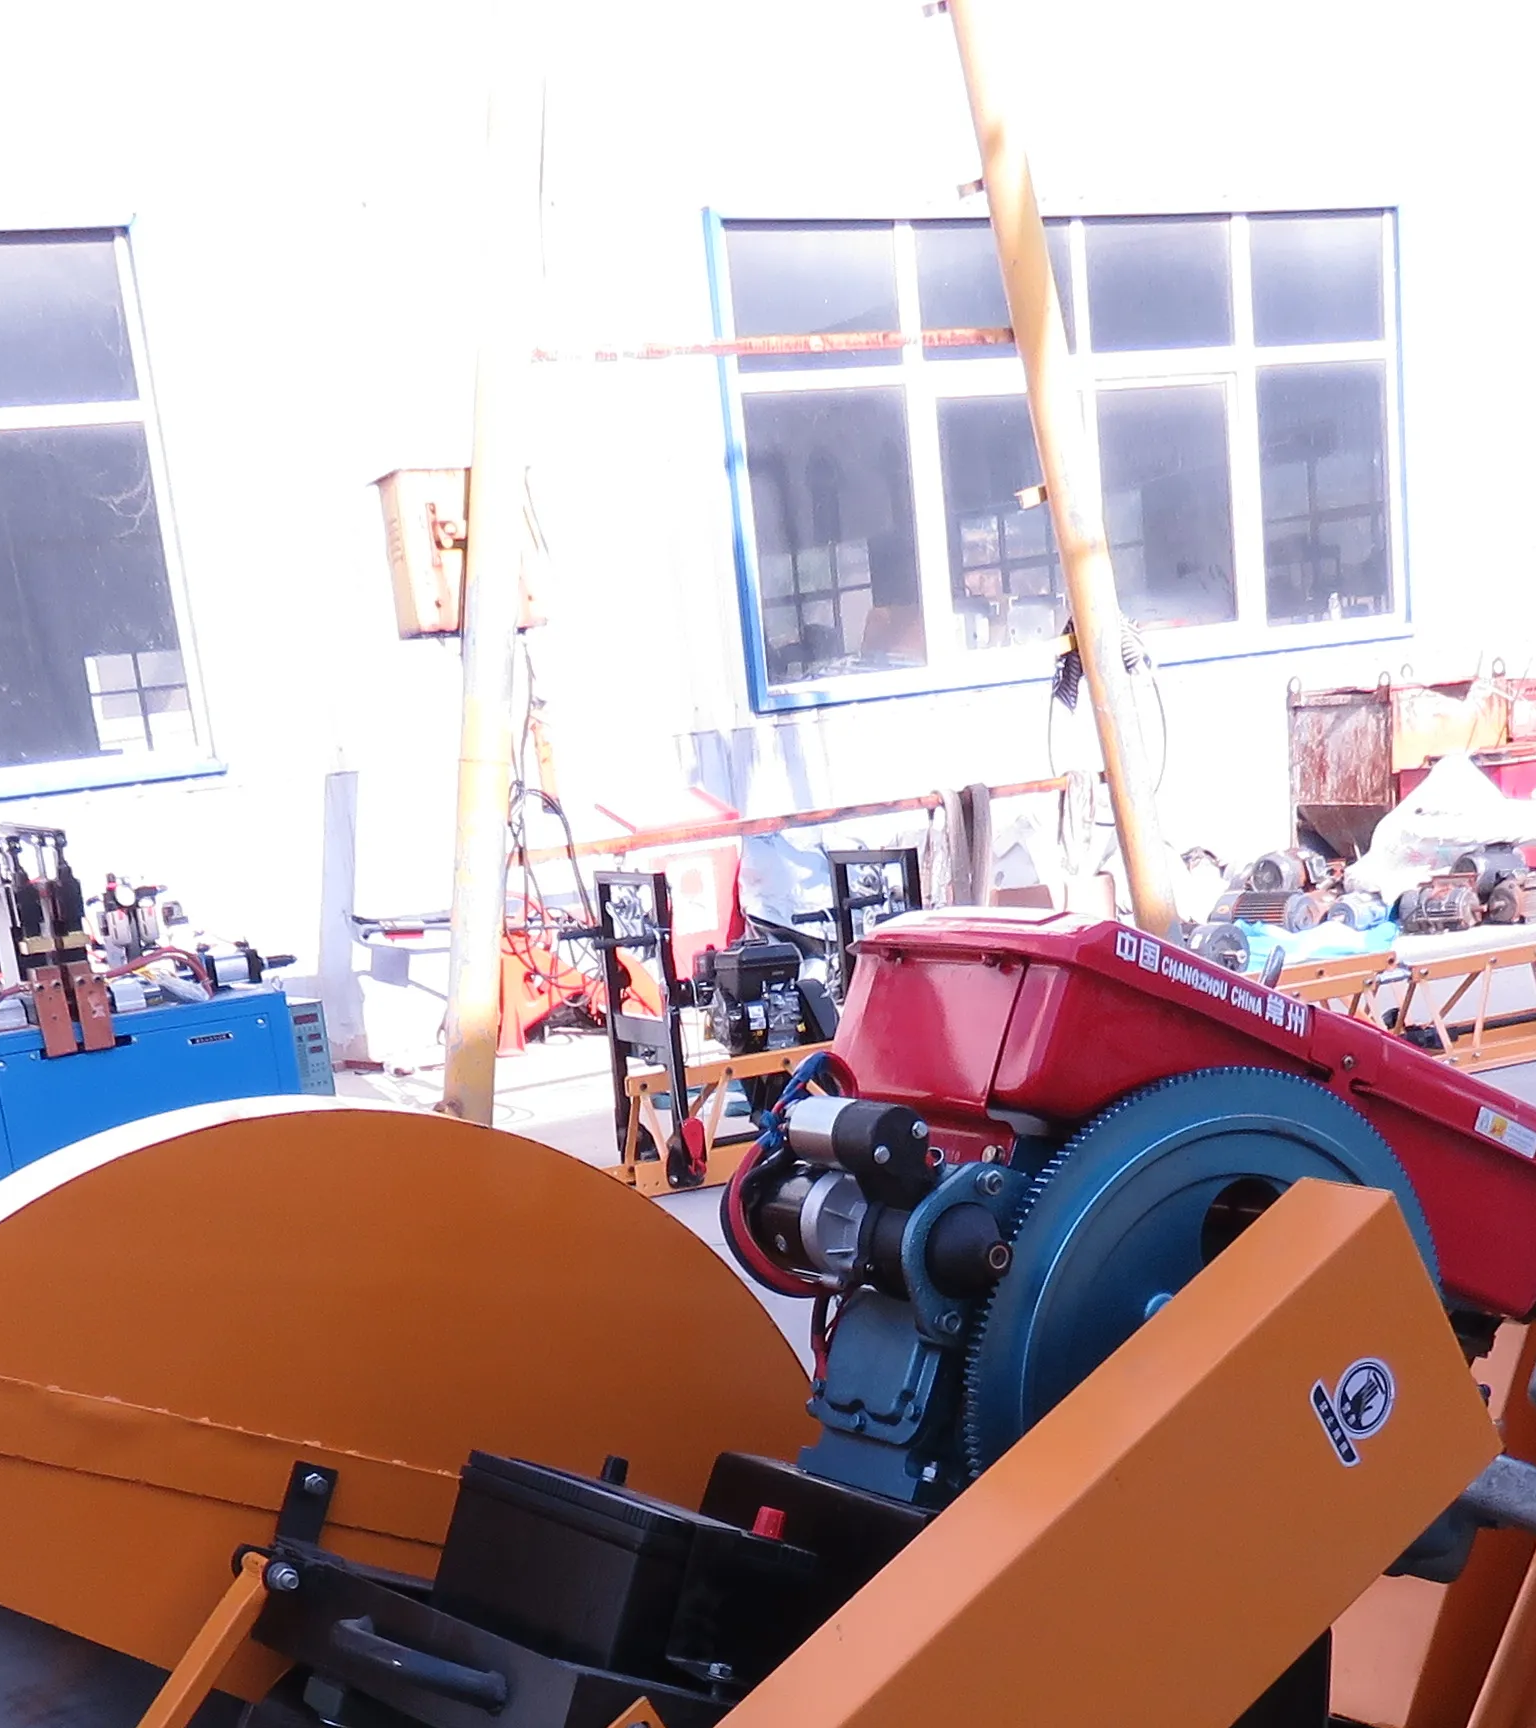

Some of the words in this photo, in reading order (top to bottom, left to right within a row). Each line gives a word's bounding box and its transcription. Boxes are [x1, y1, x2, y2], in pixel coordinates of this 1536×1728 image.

[1116, 931, 1160, 973] 中国
[1161, 956, 1228, 1001] CHANGZHOU
[1231, 986, 1262, 1017] CHINA
[1265, 994, 1306, 1037] 常州
